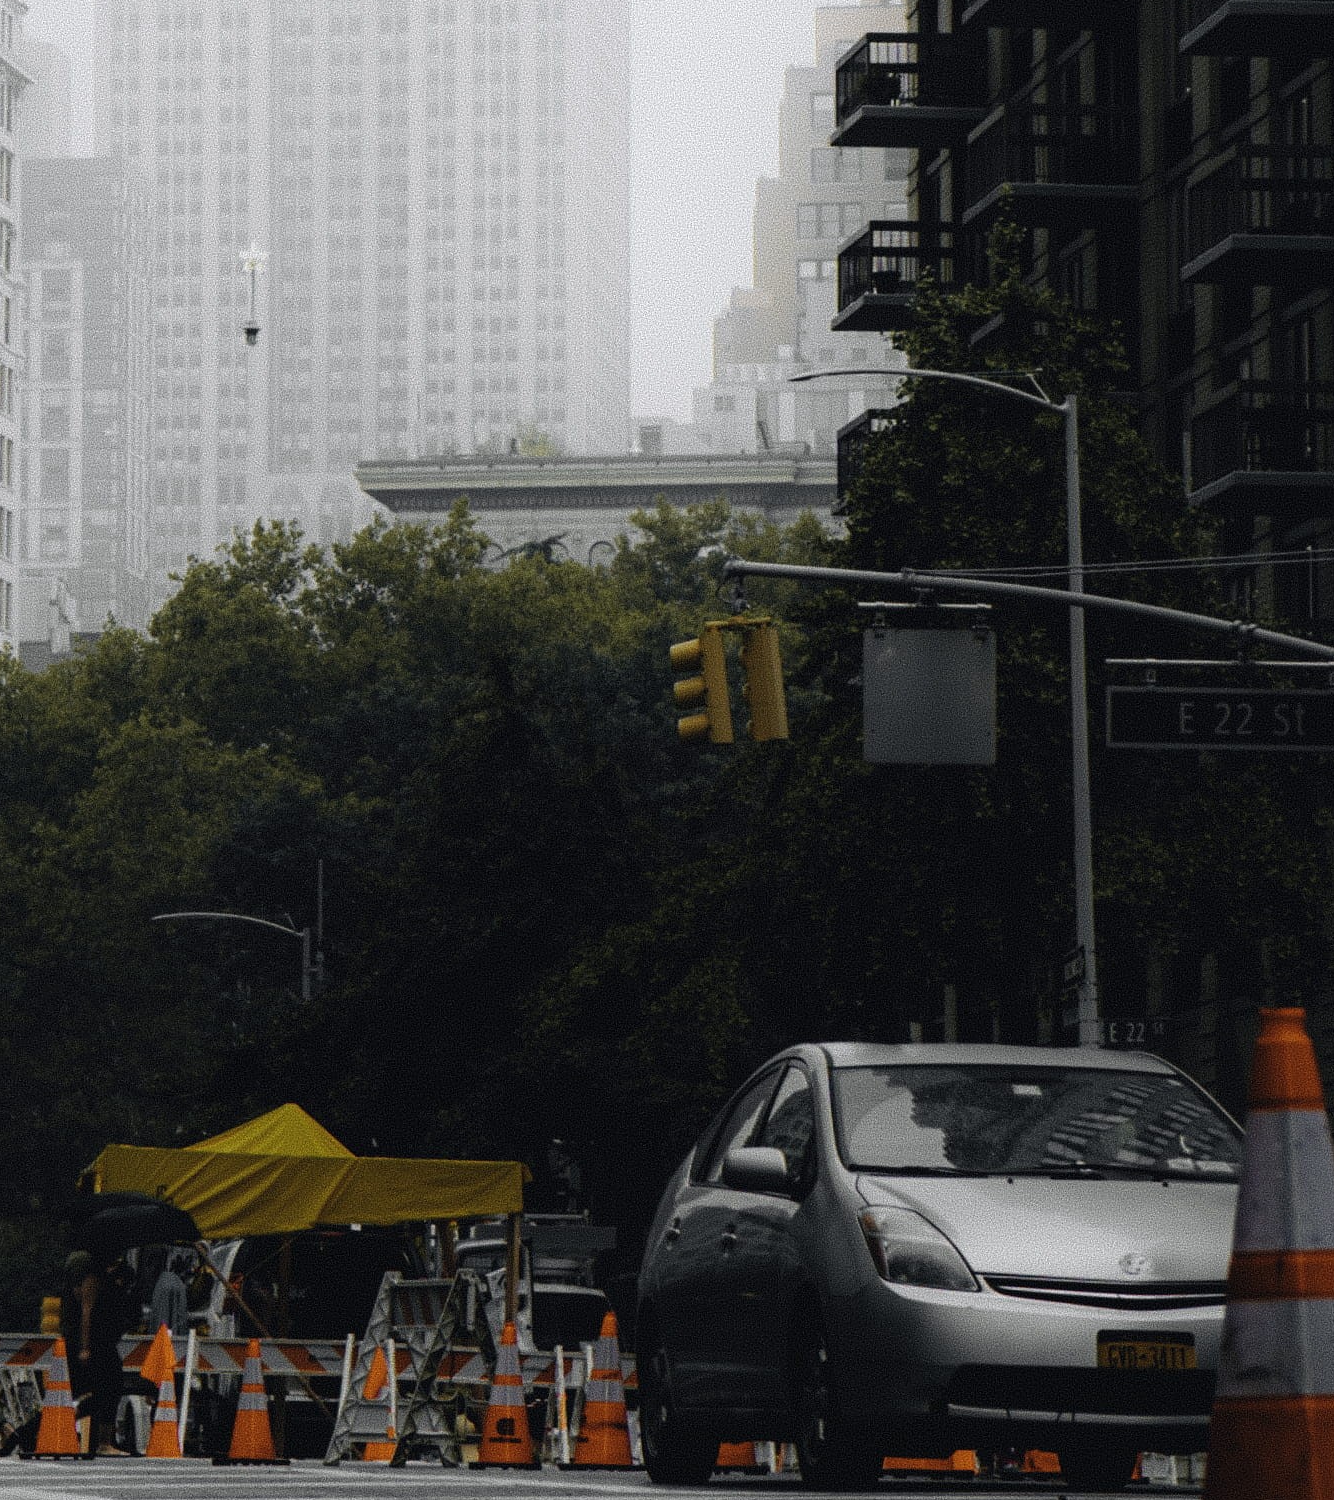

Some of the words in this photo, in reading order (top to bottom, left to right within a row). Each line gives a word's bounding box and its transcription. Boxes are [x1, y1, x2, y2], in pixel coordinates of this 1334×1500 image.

[1178, 701, 1196, 735] E
[1213, 701, 1254, 736] 22
[1272, 702, 1306, 737] St
[1108, 1021, 1117, 1044] E
[1125, 1021, 1146, 1044] 22
